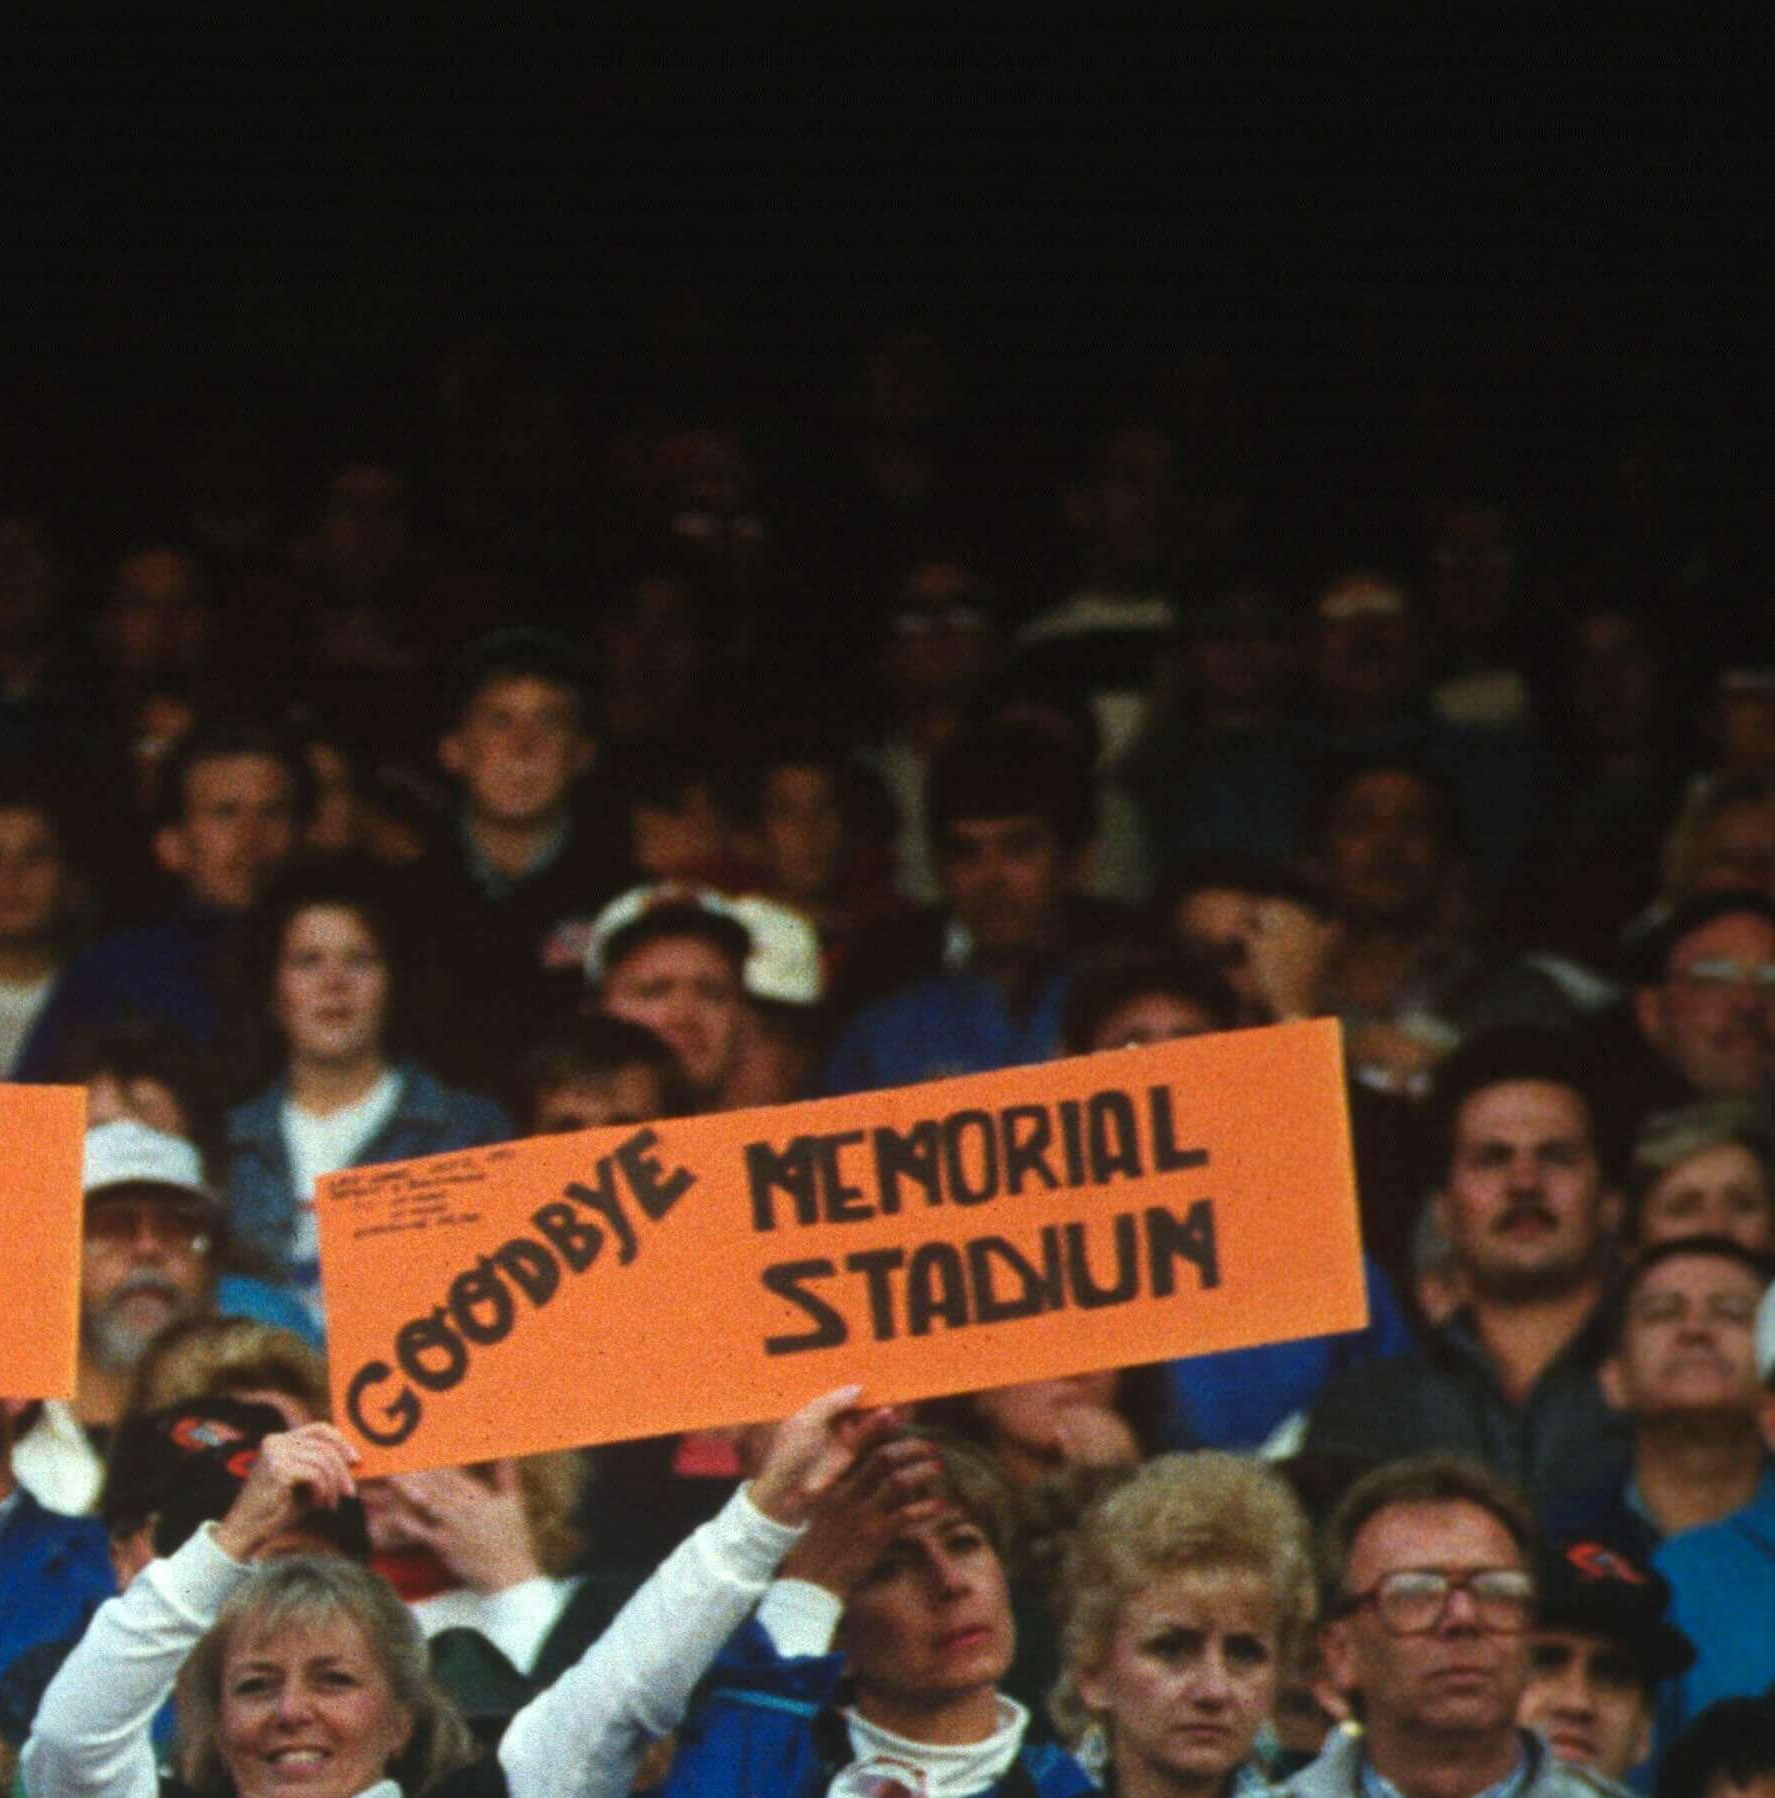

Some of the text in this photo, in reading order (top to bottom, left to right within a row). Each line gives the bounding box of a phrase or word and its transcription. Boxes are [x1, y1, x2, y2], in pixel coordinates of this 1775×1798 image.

[744, 1083, 1210, 1233] MEMORIAL
[343, 1127, 698, 1448] GOODBYE
[761, 1198, 1221, 1356] STADIUM
